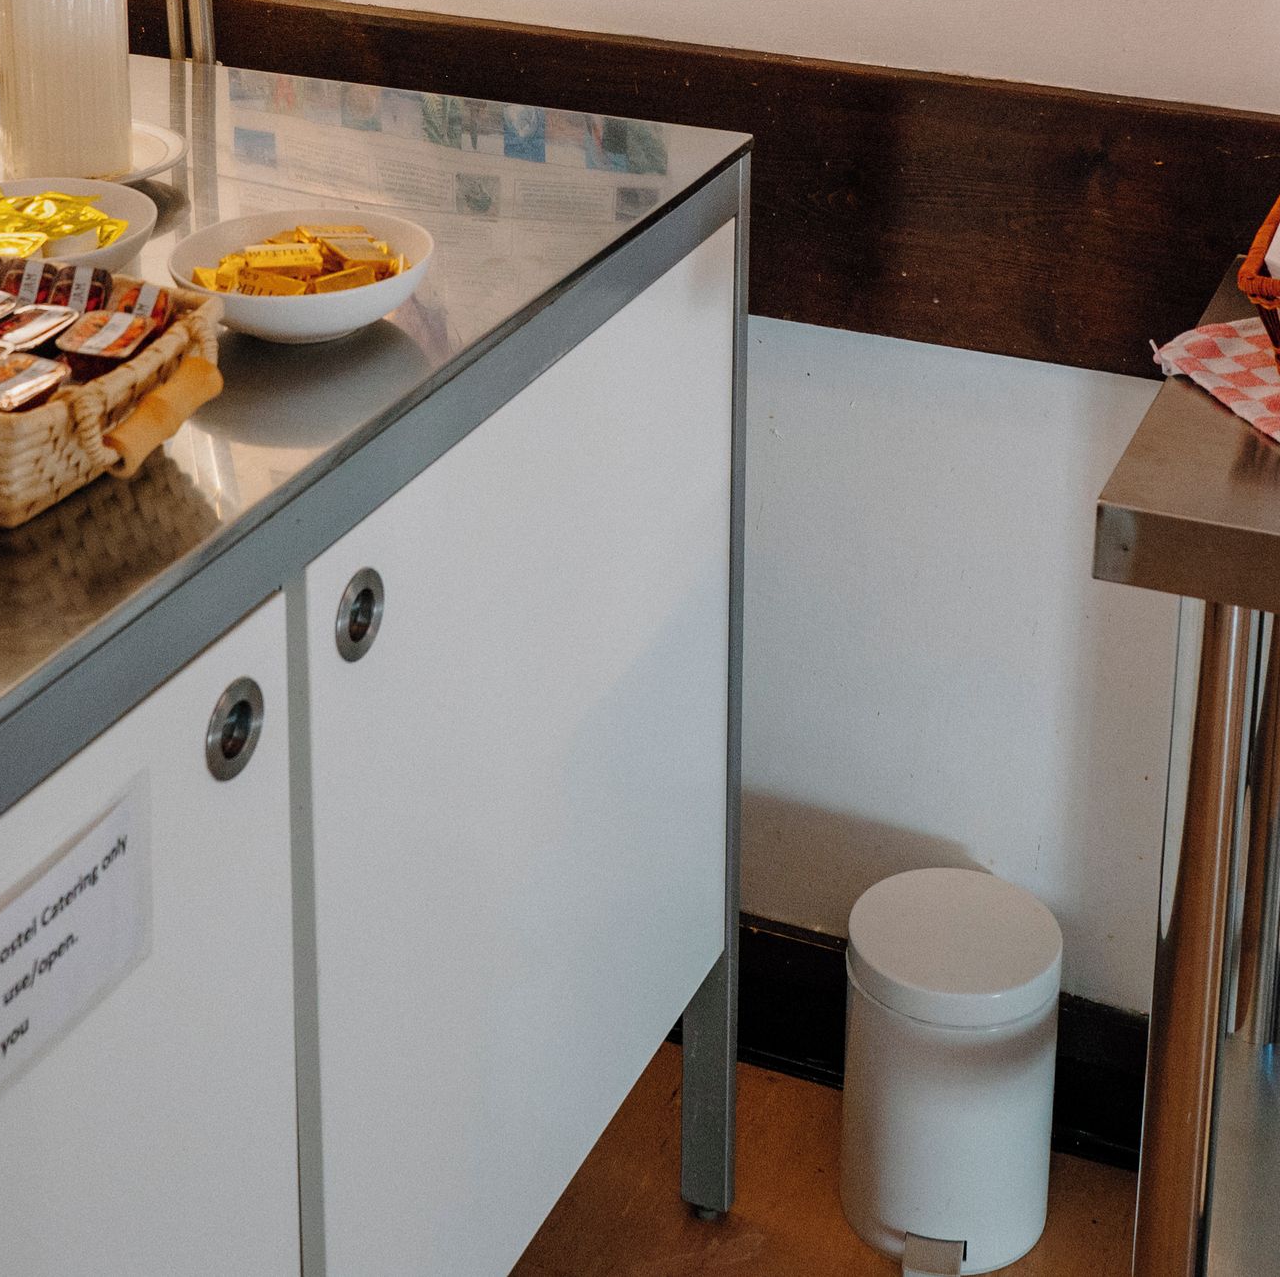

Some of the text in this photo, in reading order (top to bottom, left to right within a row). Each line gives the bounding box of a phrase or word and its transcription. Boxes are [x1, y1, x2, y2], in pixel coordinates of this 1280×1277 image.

[40, 865, 98, 926] Catering
[102, 834, 128, 871] only
[4, 932, 79, 1006] use/open.
[0, 1019, 30, 1058] you
